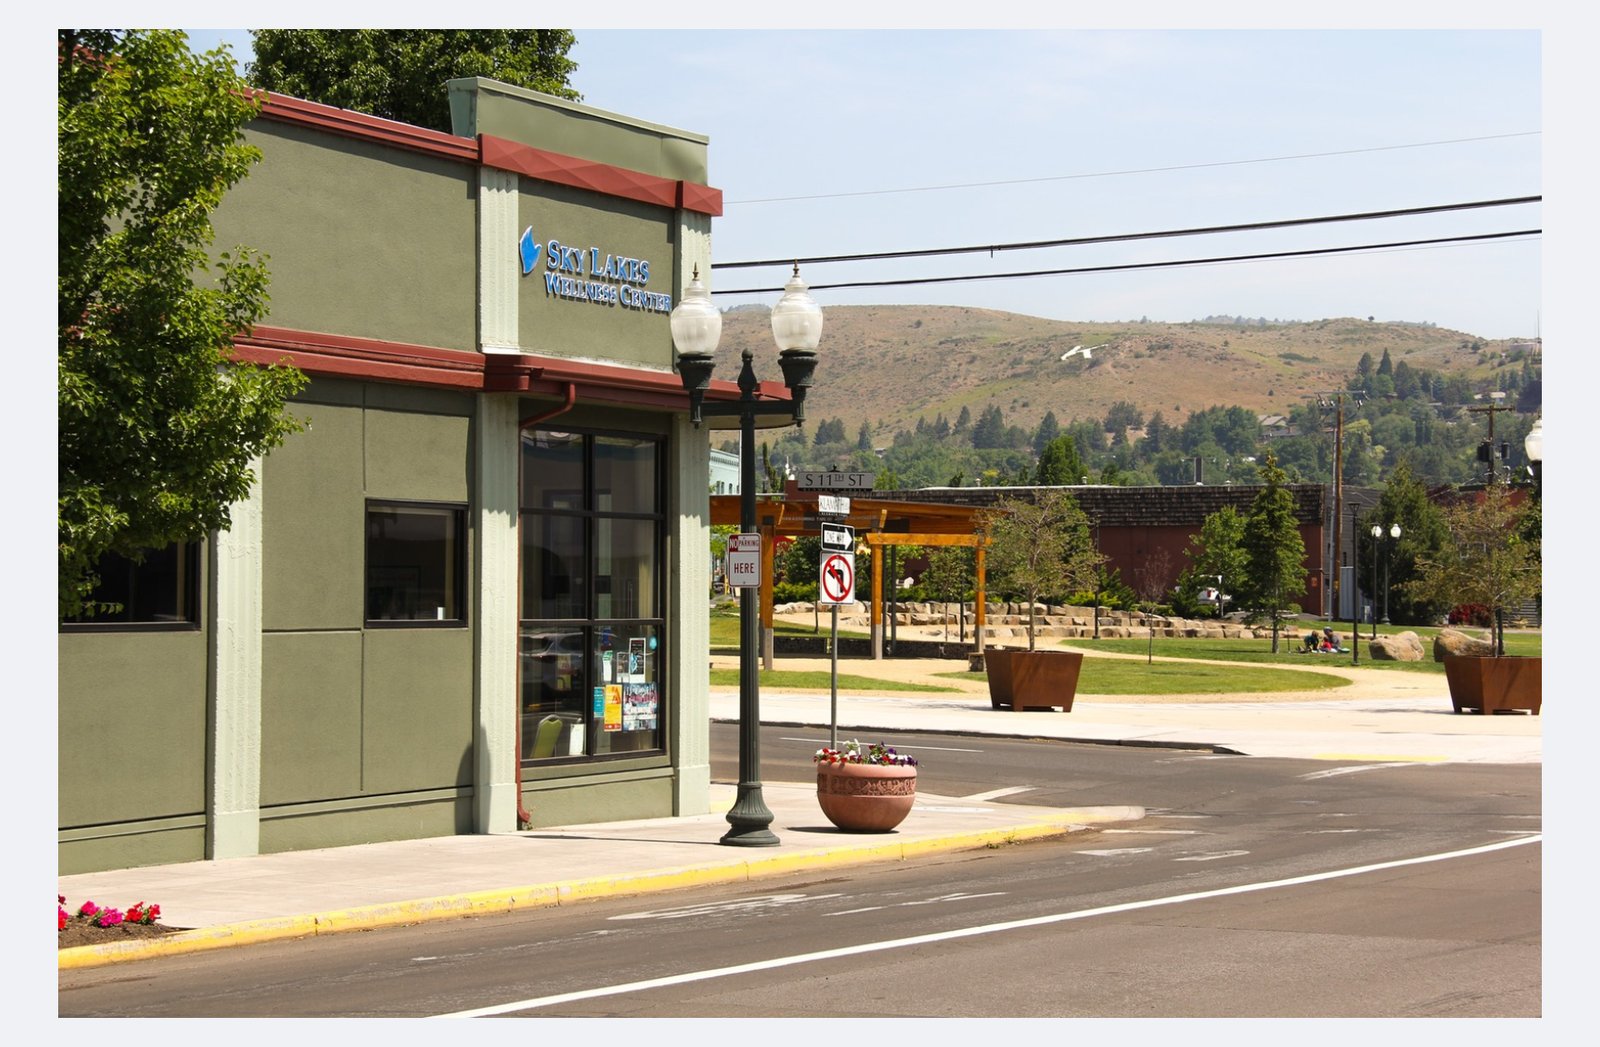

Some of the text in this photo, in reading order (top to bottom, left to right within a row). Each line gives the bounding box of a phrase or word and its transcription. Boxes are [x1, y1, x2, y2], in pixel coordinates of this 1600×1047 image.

[547, 239, 649, 285] SKY LAKES
[544, 271, 672, 313] WELLNESS CENTER
[805, 473, 814, 487] S
[848, 473, 865, 487] ST
[730, 538, 738, 548] NO
[734, 562, 755, 574] HERE
